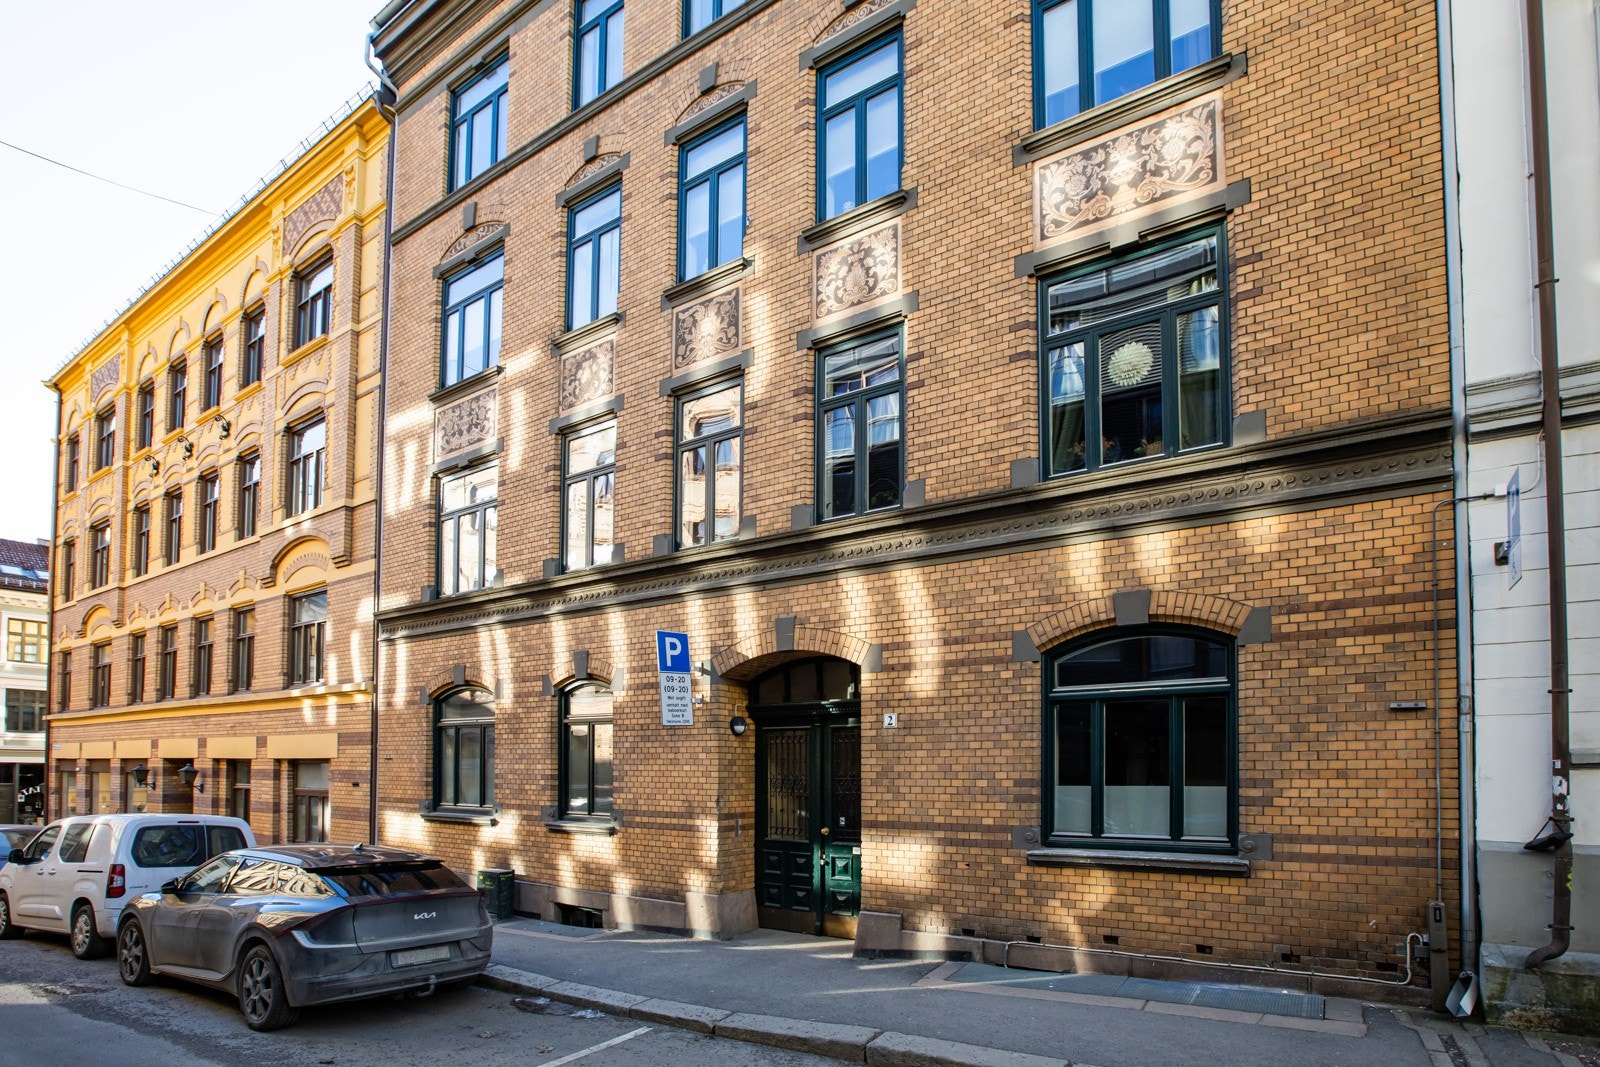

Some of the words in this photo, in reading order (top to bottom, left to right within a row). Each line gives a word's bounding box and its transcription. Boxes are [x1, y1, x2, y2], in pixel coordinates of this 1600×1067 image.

[665, 637, 681, 666] P
[666, 675, 685, 683] 09-20
[664, 685, 688, 693] (09-20)
[887, 715, 893, 726] 2
[413, 911, 437, 920] KIA
